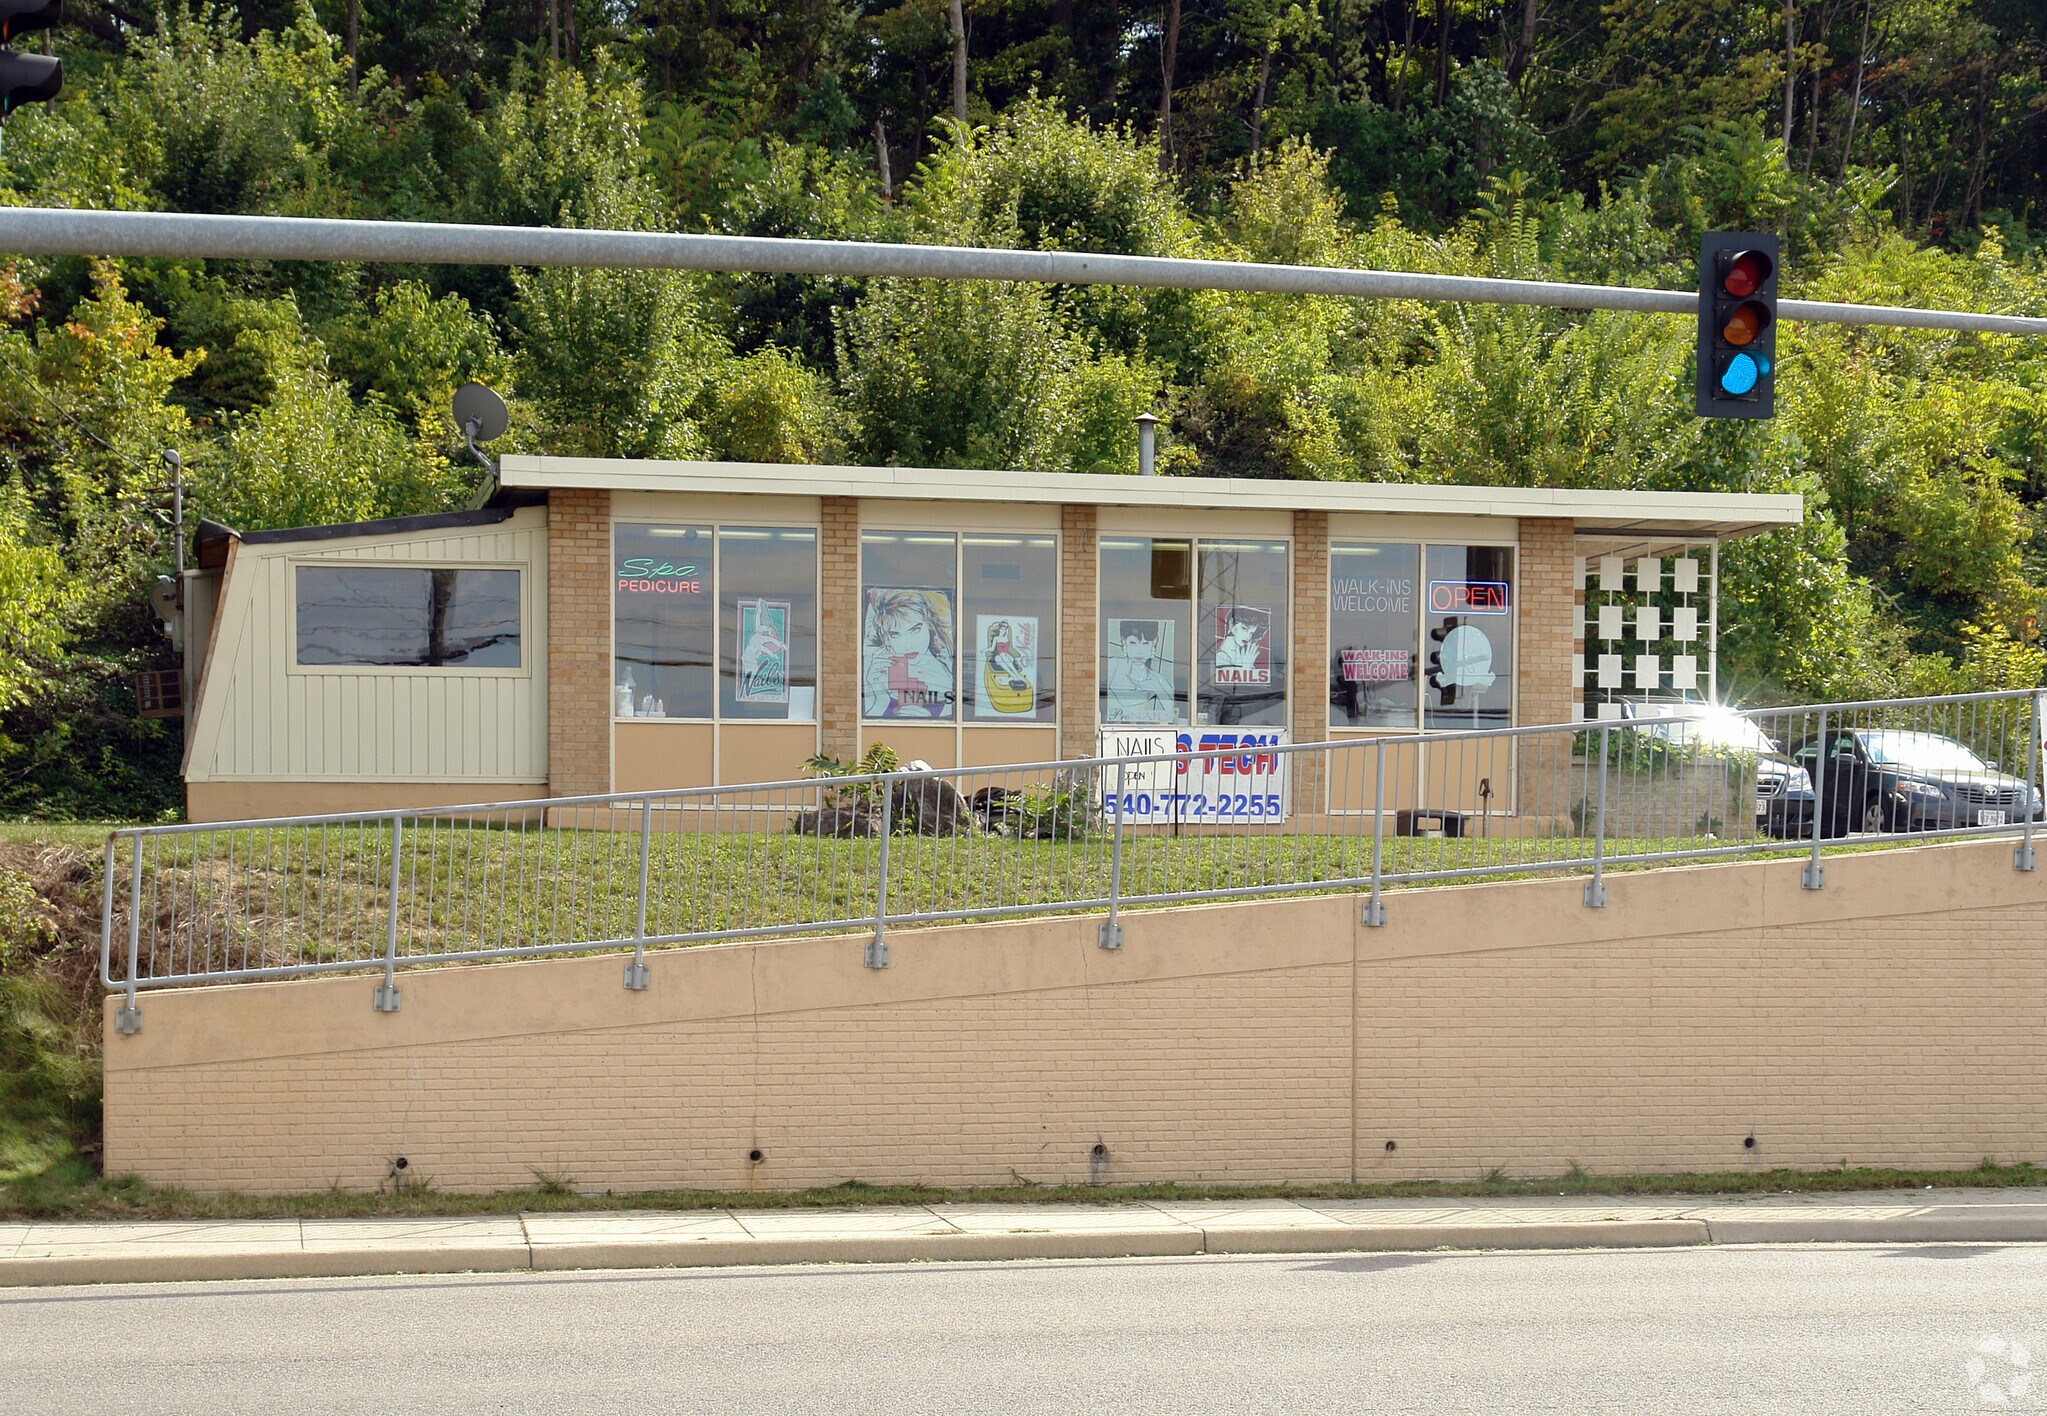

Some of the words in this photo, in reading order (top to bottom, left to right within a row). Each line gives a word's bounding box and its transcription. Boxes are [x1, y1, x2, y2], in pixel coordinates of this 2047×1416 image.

[617, 558, 698, 579] Spa
[617, 579, 700, 594] PEDICURE
[1332, 596, 1410, 613] WELCOME
[1432, 585, 1505, 611] OPEN
[1341, 650, 1408, 662] WALK-INS
[739, 658, 782, 698] Nails
[1217, 670, 1268, 683] NAILS
[1343, 661, 1408, 681] WELCOME
[903, 690, 955, 705] NAILS
[1199, 734, 1279, 775] TECH
[1105, 794, 1280, 816] 540-772-2255
